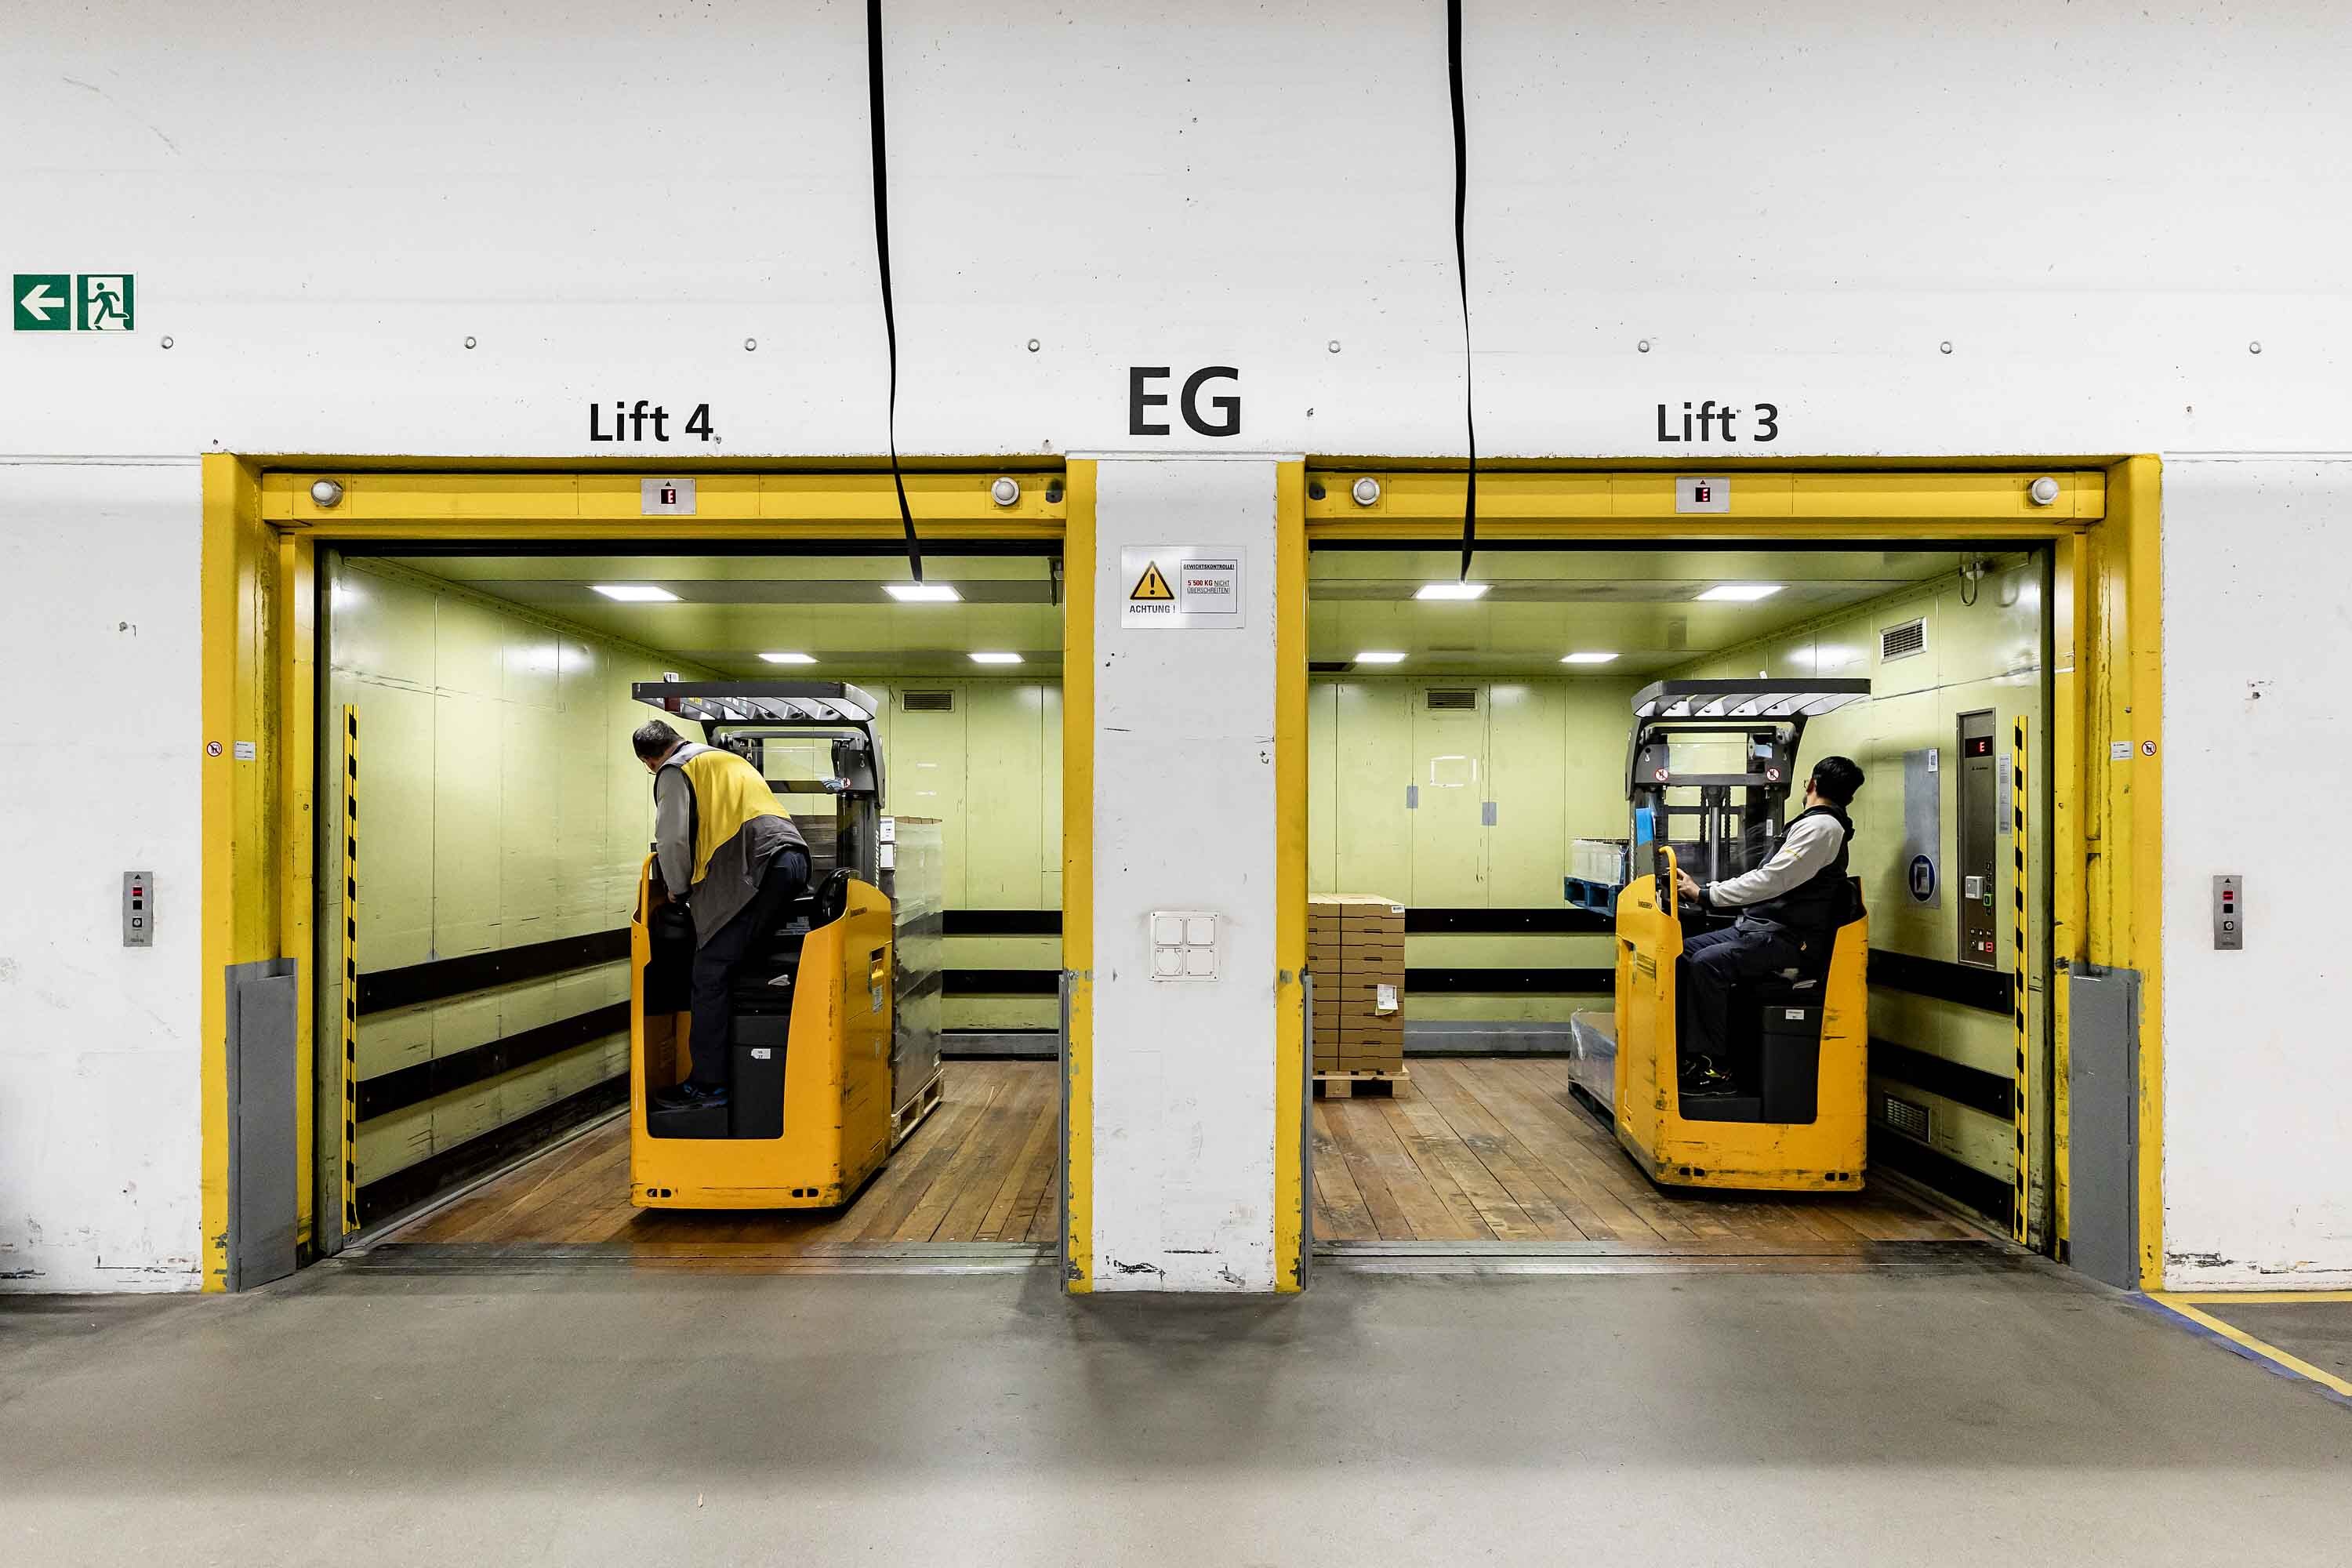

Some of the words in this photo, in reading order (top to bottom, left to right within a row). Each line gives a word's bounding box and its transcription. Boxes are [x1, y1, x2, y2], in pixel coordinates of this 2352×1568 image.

[1129, 365, 1241, 437] EG
[590, 400, 670, 442] Lift
[684, 403, 714, 441] 4
[1657, 401, 1737, 442] Lift
[1754, 403, 1778, 442] 3
[667, 490, 673, 503] E
[1702, 488, 1708, 502] E
[1129, 604, 1171, 613] ACHTUNG
[1979, 742, 1985, 753] E
